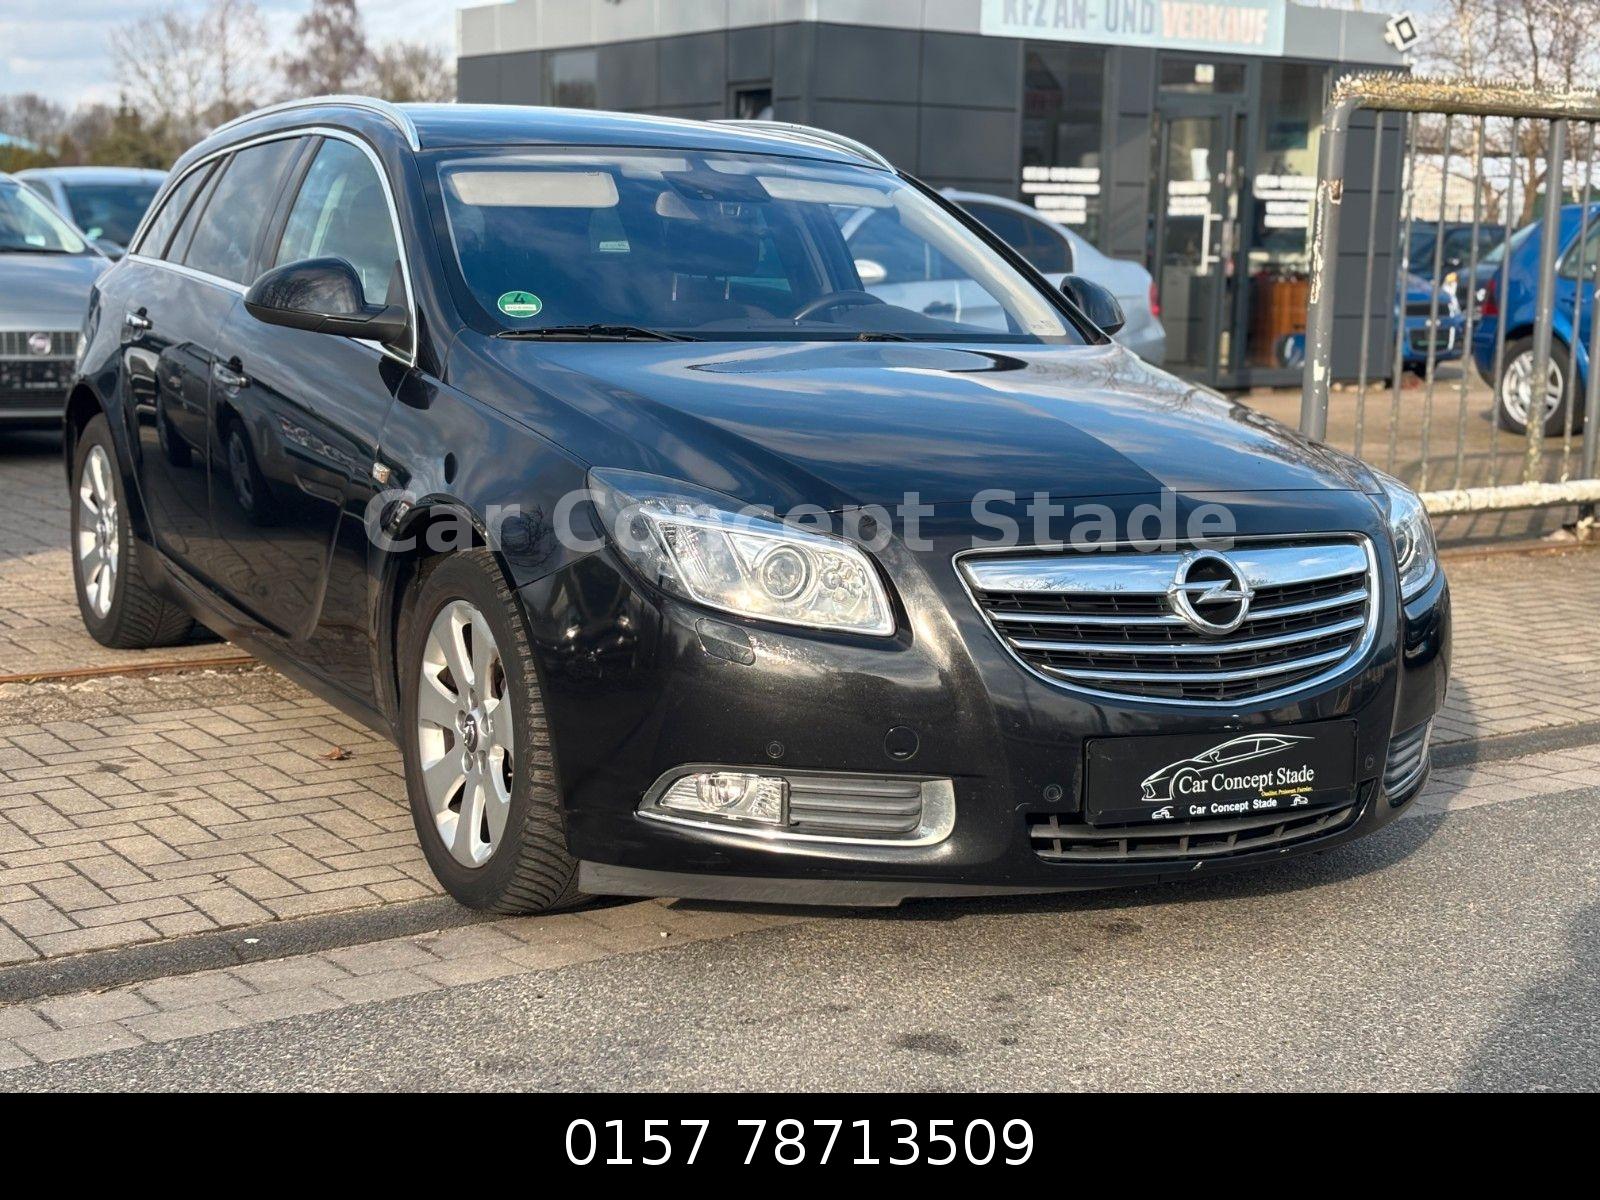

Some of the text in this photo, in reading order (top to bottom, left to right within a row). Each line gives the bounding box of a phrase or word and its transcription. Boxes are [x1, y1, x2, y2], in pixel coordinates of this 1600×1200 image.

[1105, 0, 1154, 34] UND
[1162, 3, 1267, 44] VERKAUF
[514, 293, 525, 303] 4
[1179, 776, 1208, 794] Car
[1211, 772, 1273, 792] Concept
[1276, 765, 1314, 785] Stade
[1189, 798, 1278, 815] Car Concept Stade
